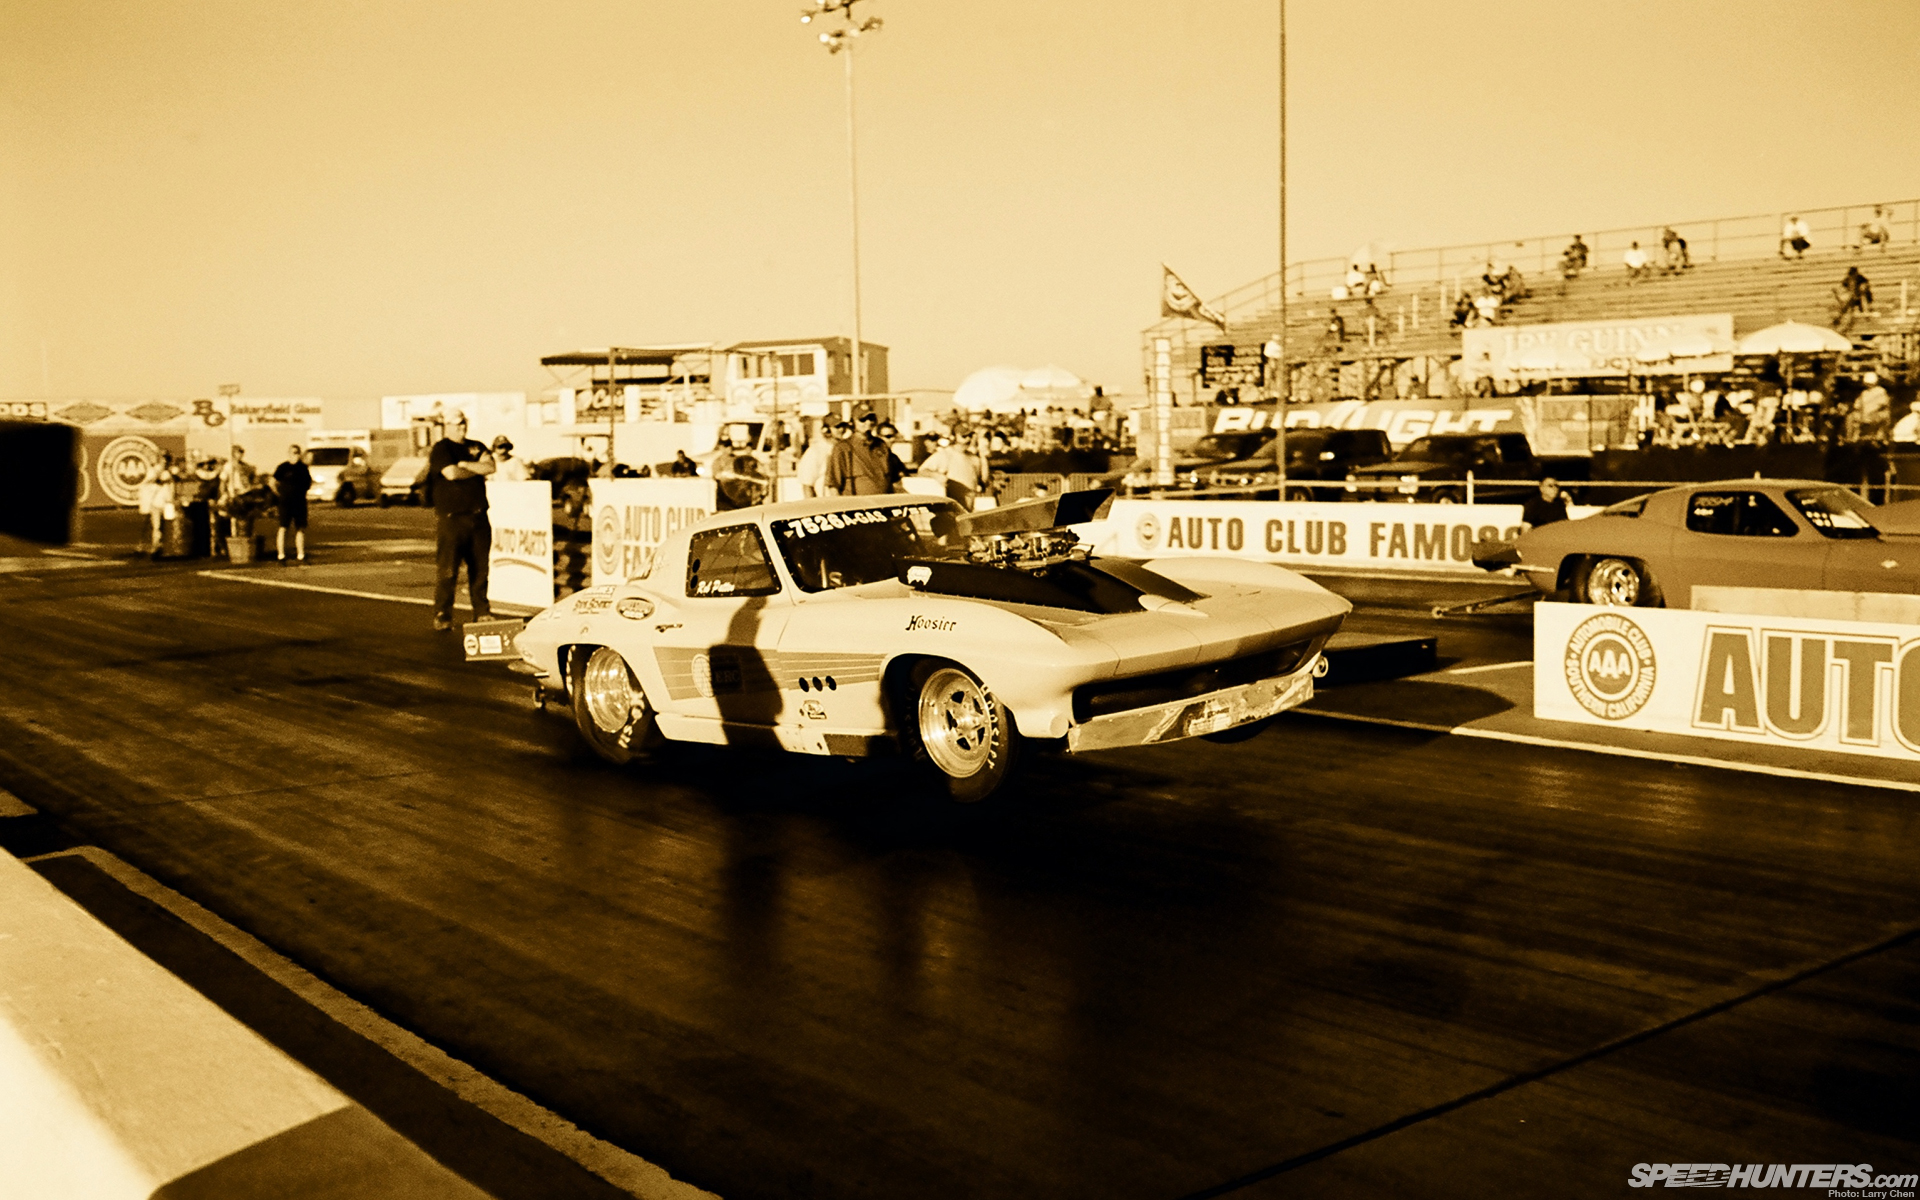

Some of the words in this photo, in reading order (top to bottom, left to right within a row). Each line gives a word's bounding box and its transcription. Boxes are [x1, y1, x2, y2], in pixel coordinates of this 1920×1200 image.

[624, 505, 661, 543] AUTO
[788, 513, 846, 539] 7526
[1167, 516, 1245, 551] AUTO
[1265, 519, 1348, 556] CLUB
[905, 614, 957, 632] Hoosier
[1569, 615, 1632, 655] AUTOMOBILE
[1627, 626, 1652, 660] CLUB
[1588, 648, 1632, 679] AAA
[1565, 658, 1608, 718] SOUTHERN
[1607, 665, 1655, 718] CALIFORNIA
